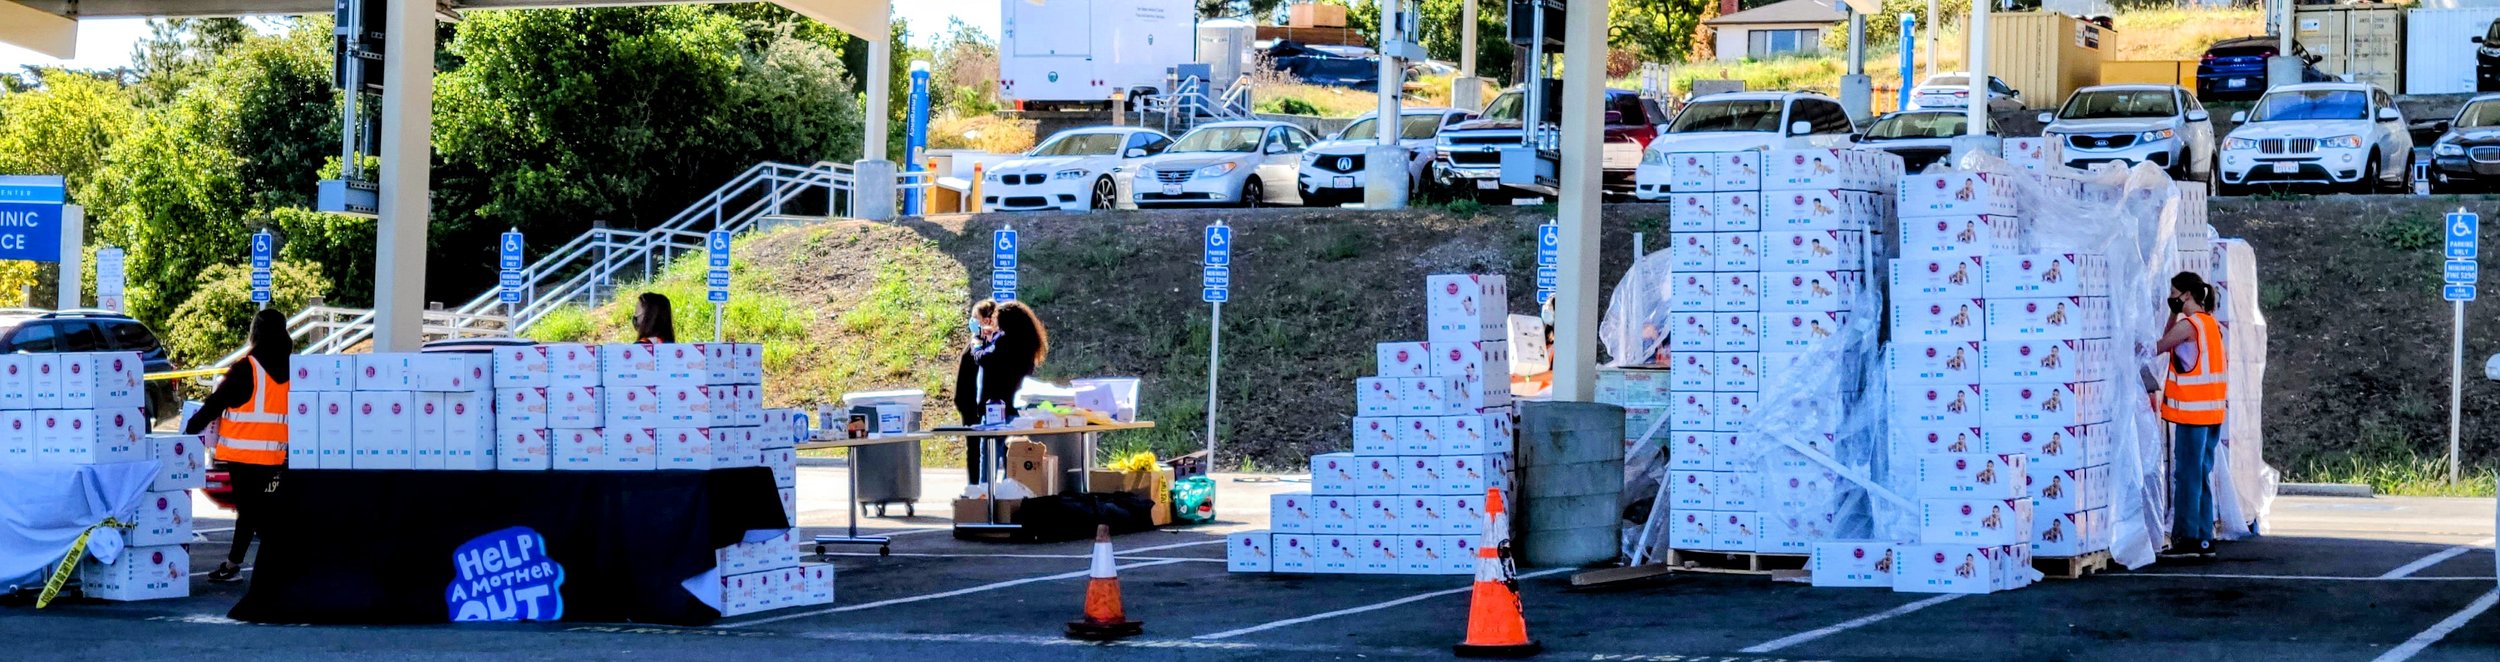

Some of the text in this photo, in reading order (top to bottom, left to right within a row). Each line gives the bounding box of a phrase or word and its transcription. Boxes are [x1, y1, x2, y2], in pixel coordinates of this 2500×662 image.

[909, 94, 918, 137] Emergency
[452, 584, 467, 602] A
[454, 584, 549, 620] OUT
